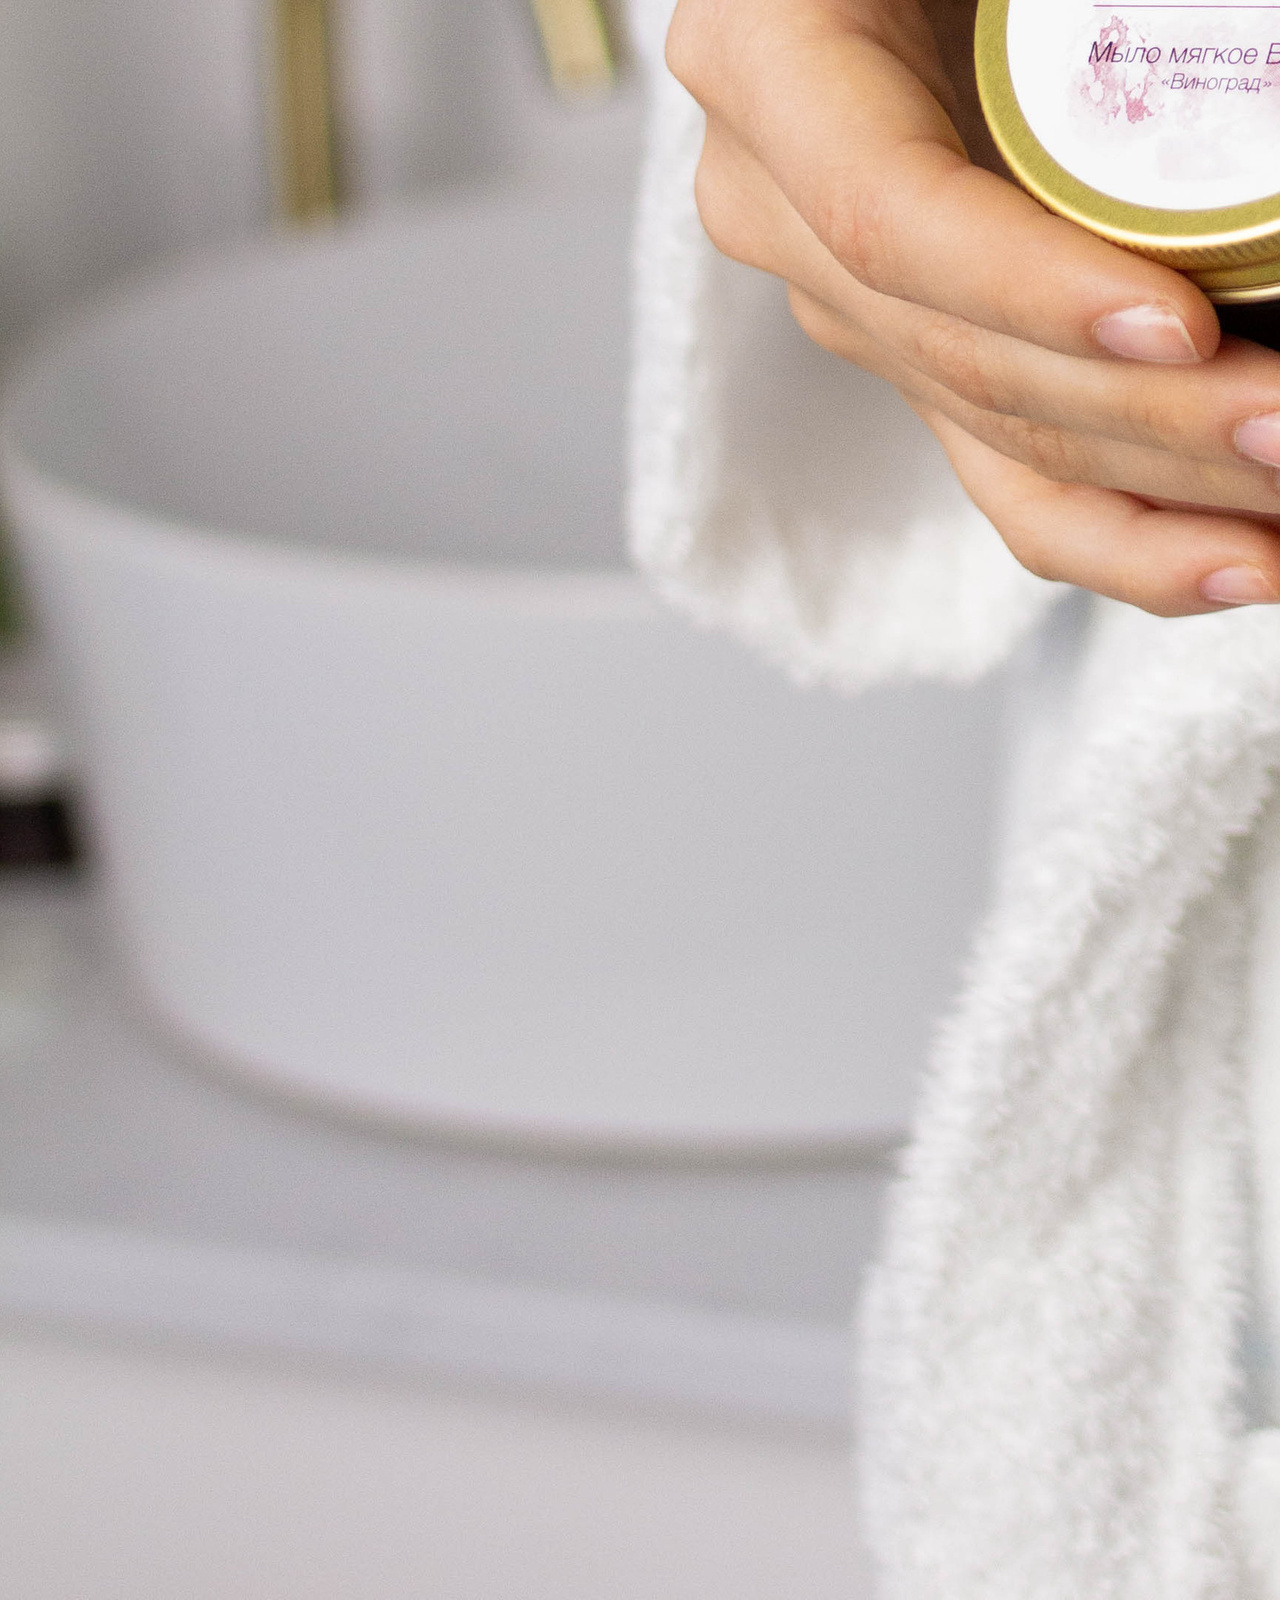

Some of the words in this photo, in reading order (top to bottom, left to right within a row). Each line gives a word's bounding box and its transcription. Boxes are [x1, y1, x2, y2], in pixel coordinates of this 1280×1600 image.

[1088, 41, 1161, 64] Мыло
[1168, 46, 1258, 65] мягкое
[1161, 73, 1273, 93] «Виноград»
